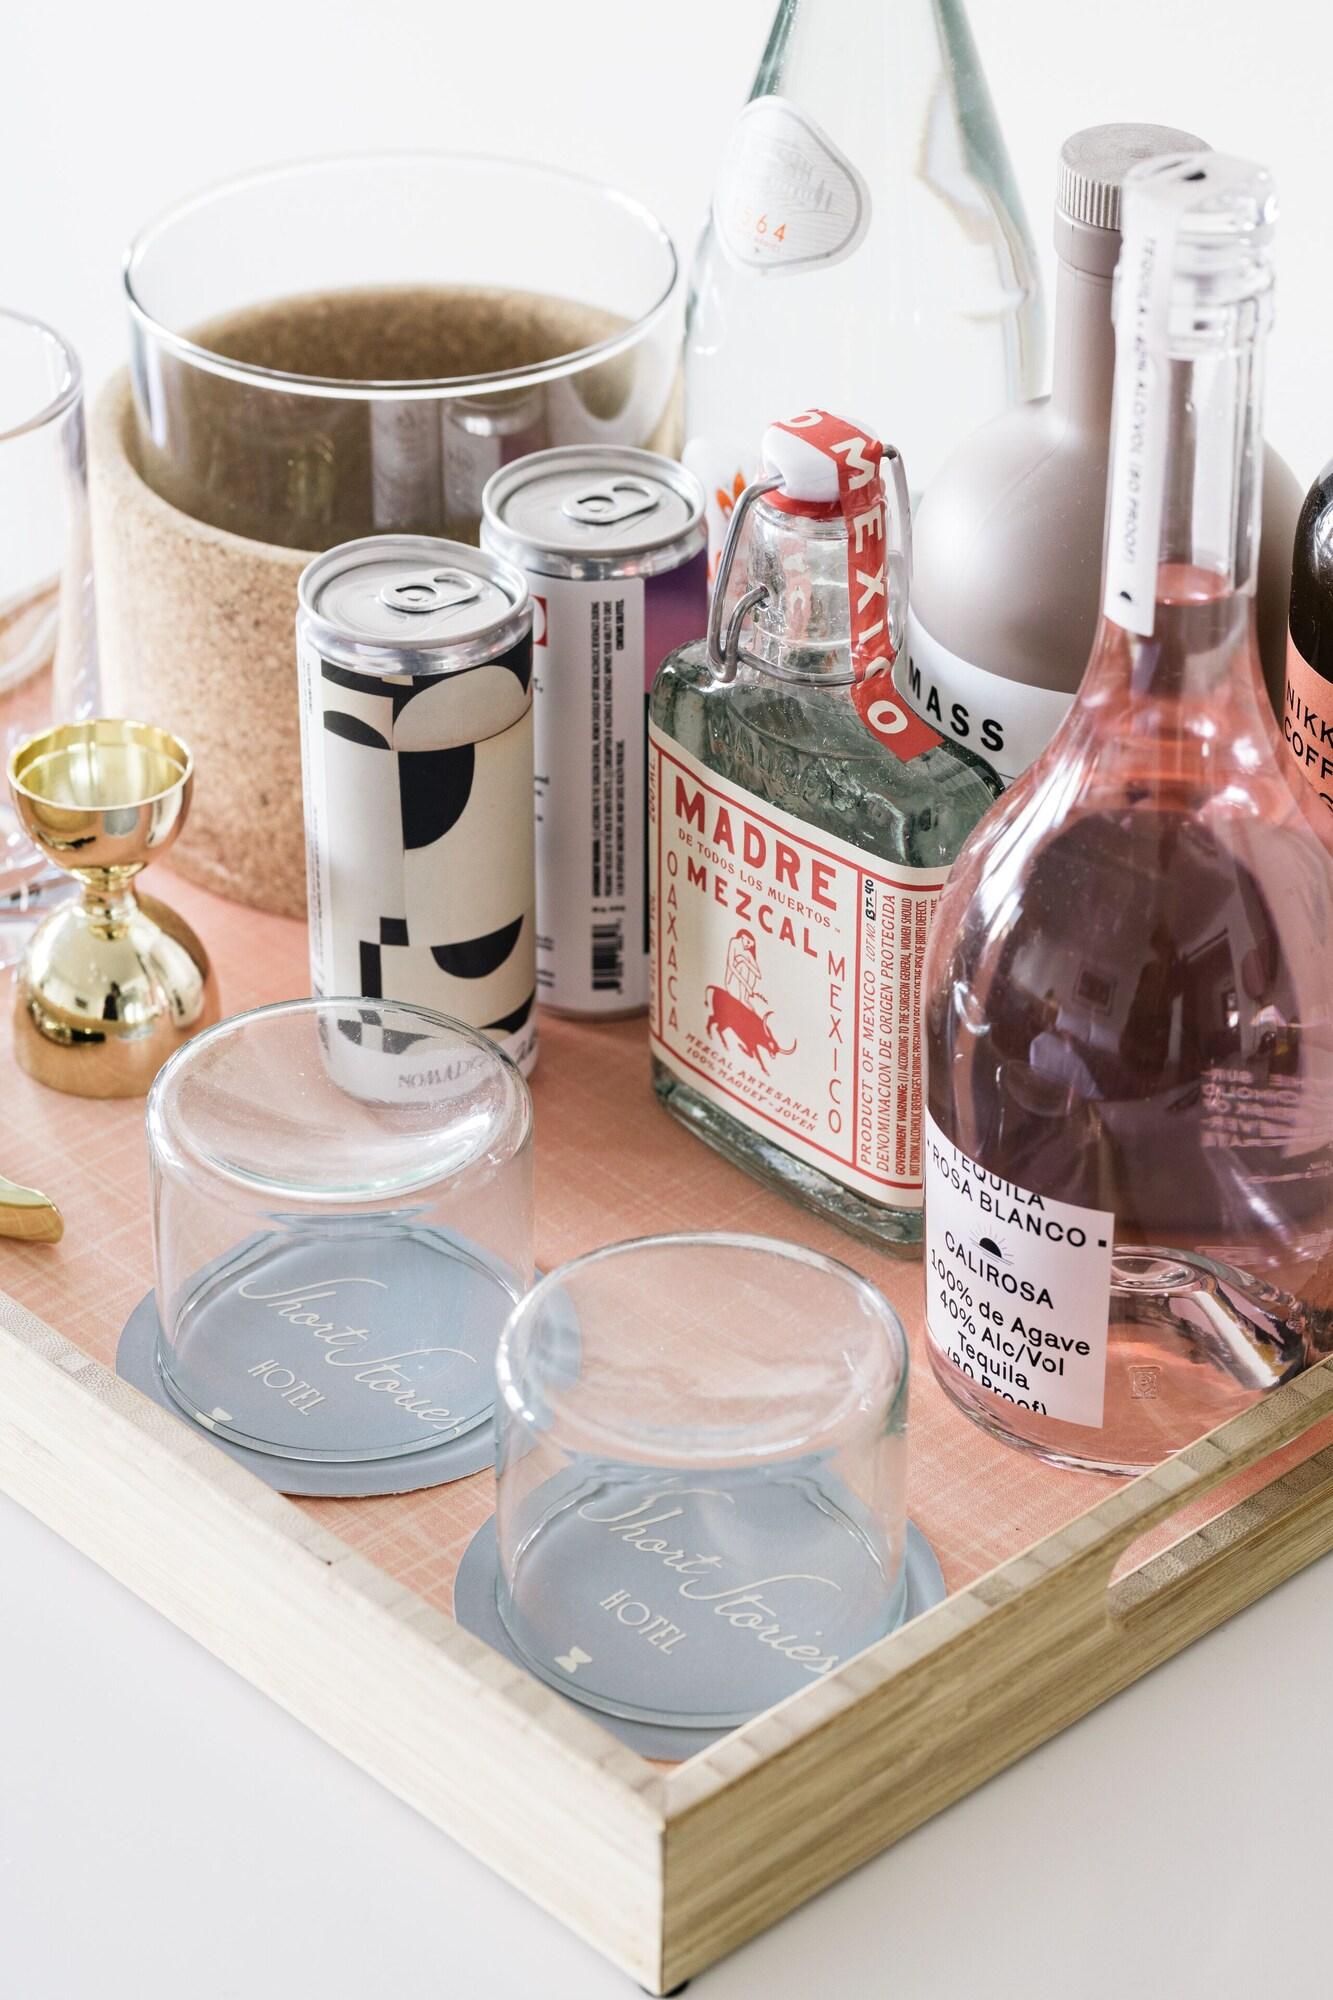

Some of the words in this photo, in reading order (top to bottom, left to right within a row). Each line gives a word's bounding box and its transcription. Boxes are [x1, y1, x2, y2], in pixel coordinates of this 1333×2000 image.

[829, 437, 908, 734] MEXICO
[908, 655, 1004, 752] MASS
[1286, 679, 1333, 749] NIKK
[1284, 716, 1333, 779] COFF
[675, 776, 837, 911] MADRE
[678, 828, 693, 847] DE
[697, 841, 735, 874] TODOS
[740, 870, 763, 892] LOS
[768, 886, 831, 928] MUERTOS
[687, 856, 818, 958] MEZCAL
[666, 851, 678, 1032] OAXACA
[880, 895, 896, 980] PROTEGIDA
[900, 898, 912, 925] SHOULD
[900, 926, 912, 950] WOMEN
[915, 927, 926, 944] BIRTH
[865, 938, 876, 963] LOT
[900, 953, 912, 981] GENERAL,
[915, 944, 926, 954] OF
[863, 970, 876, 1042] MEXICO
[879, 982, 893, 1034] ORIGEN
[898, 1011, 910, 1025] THE
[899, 981, 911, 1012] SURGEON
[828, 950, 845, 1133] MEXICO
[862, 1047, 874, 1073] OF
[879, 1038, 892, 1060] DE
[897, 1035, 909, 1072] ACCORDING
[898, 1025, 910, 1035] TO
[685, 1033, 734, 1070] MEZCAL
[738, 1070, 819, 1120] ARTESANAL
[686, 1047, 715, 1070] 100%
[718, 1069, 767, 1101] MAGUEY
[775, 1107, 816, 1131] JOVEN
[896, 1082, 908, 1122] WARNING:
[911, 1077, 922, 1111] BEVERAGES
[861, 1079, 873, 1165] PRODUCT
[876, 1061, 892, 1172] DENOMINACION
[910, 1111, 921, 1144] ALCOHOLIC
[895, 1124, 907, 1175] GOVERNMENT
[909, 1163, 920, 1176] NOT
[910, 1144, 920, 1163] DRINK
[933, 1145, 973, 1201] ROSA
[980, 1191, 1086, 1248] BLANCO
[945, 1231, 1054, 1309] CALIROSA
[931, 1249, 973, 1307] 100%
[979, 1302, 1004, 1326] de
[1010, 1317, 1090, 1355] Agave
[940, 1290, 976, 1335] 40%
[981, 1327, 1064, 1376] Alc/Vol
[238, 1278, 388, 1345] Short
[325, 1348, 477, 1429] Stories
[958, 1331, 1030, 1390] Tequila
[248, 1359, 327, 1416] HOTEL
[577, 1488, 735, 1575] Short
[679, 1574, 842, 1673] Stories
[599, 1589, 686, 1655] HOTEL
